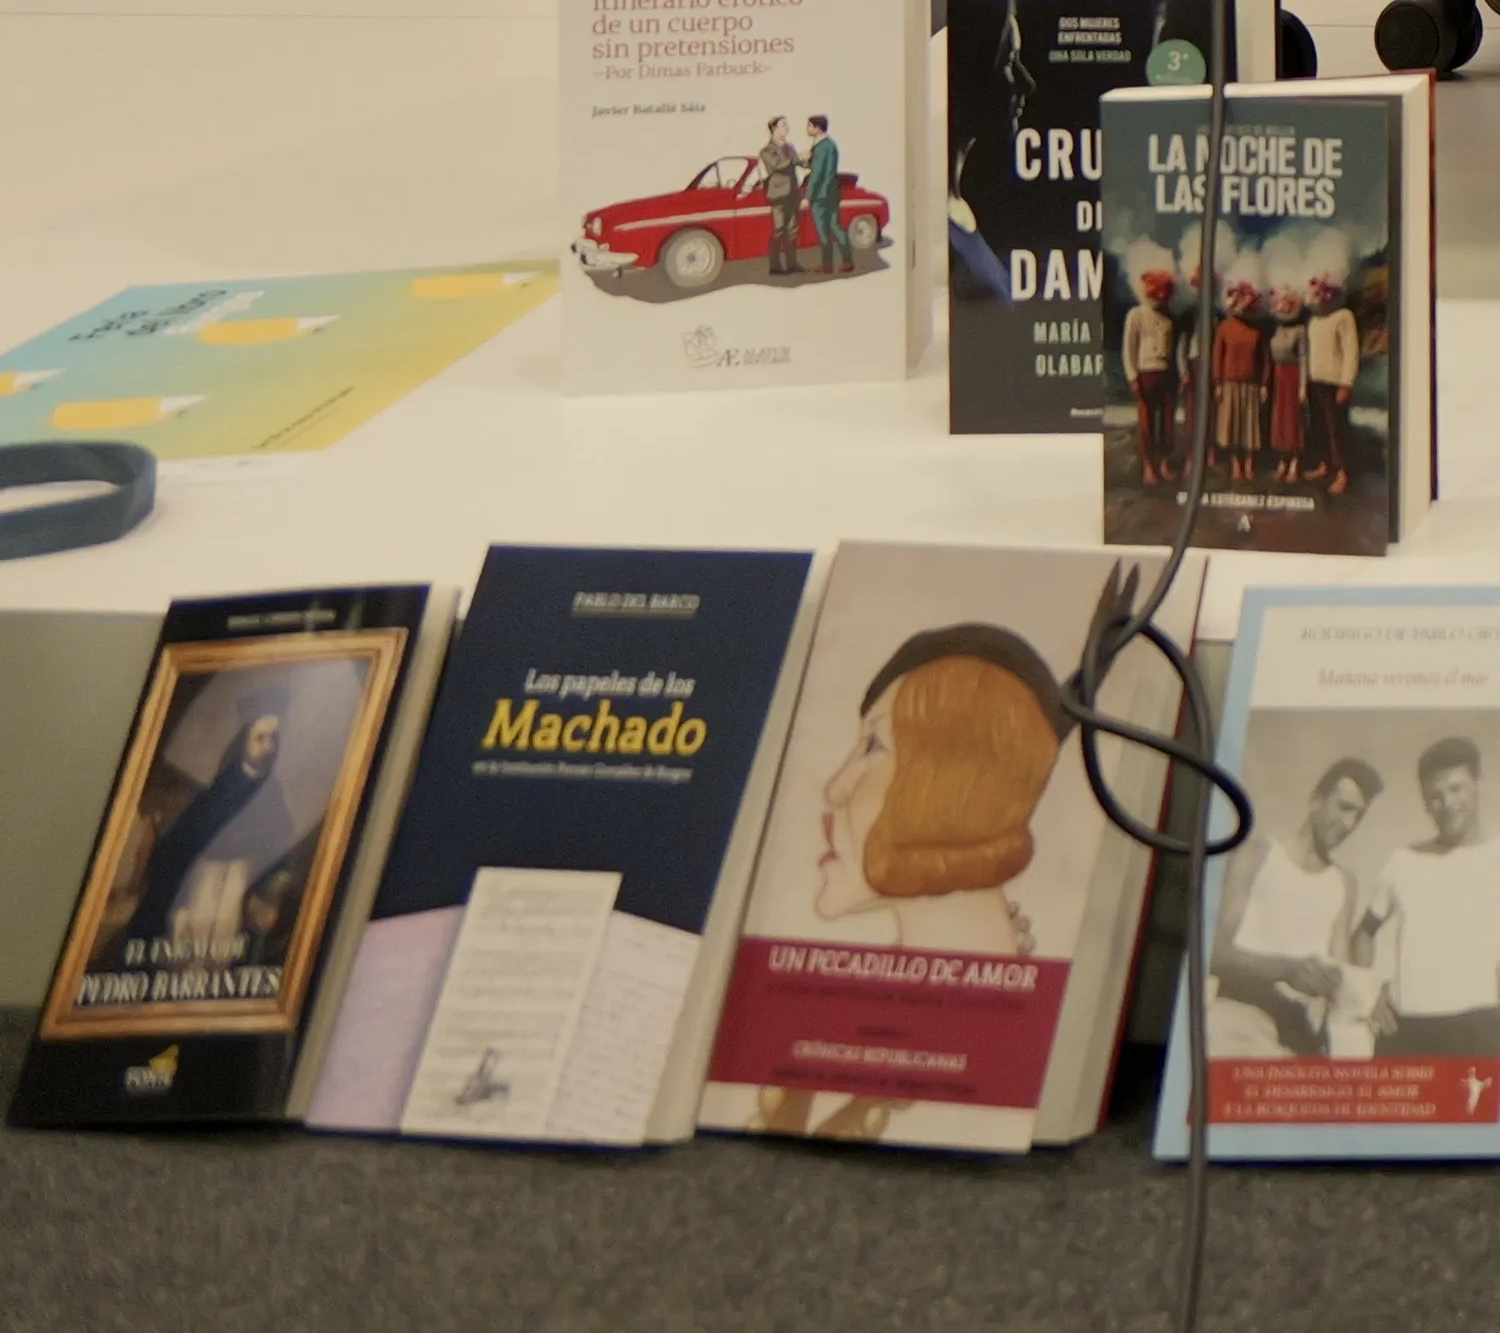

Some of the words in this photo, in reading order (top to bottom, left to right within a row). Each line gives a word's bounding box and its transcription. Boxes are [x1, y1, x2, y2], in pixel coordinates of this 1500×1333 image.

[592, 14, 622, 35] de
[629, 17, 660, 34] un
[667, 14, 753, 37] cuerpo
[592, 38, 630, 60] sin
[637, 36, 795, 63] pretensiones
[1149, 133, 1188, 173] LA
[1303, 137, 1343, 178] DE
[1155, 174, 1207, 213] LAS
[1221, 176, 1336, 219] FLORES
[1033, 318, 1091, 344] MARÍA
[558, 669, 639, 702] papeles
[638, 670, 665, 698] de
[664, 671, 697, 699] los
[480, 697, 708, 757] Machado
